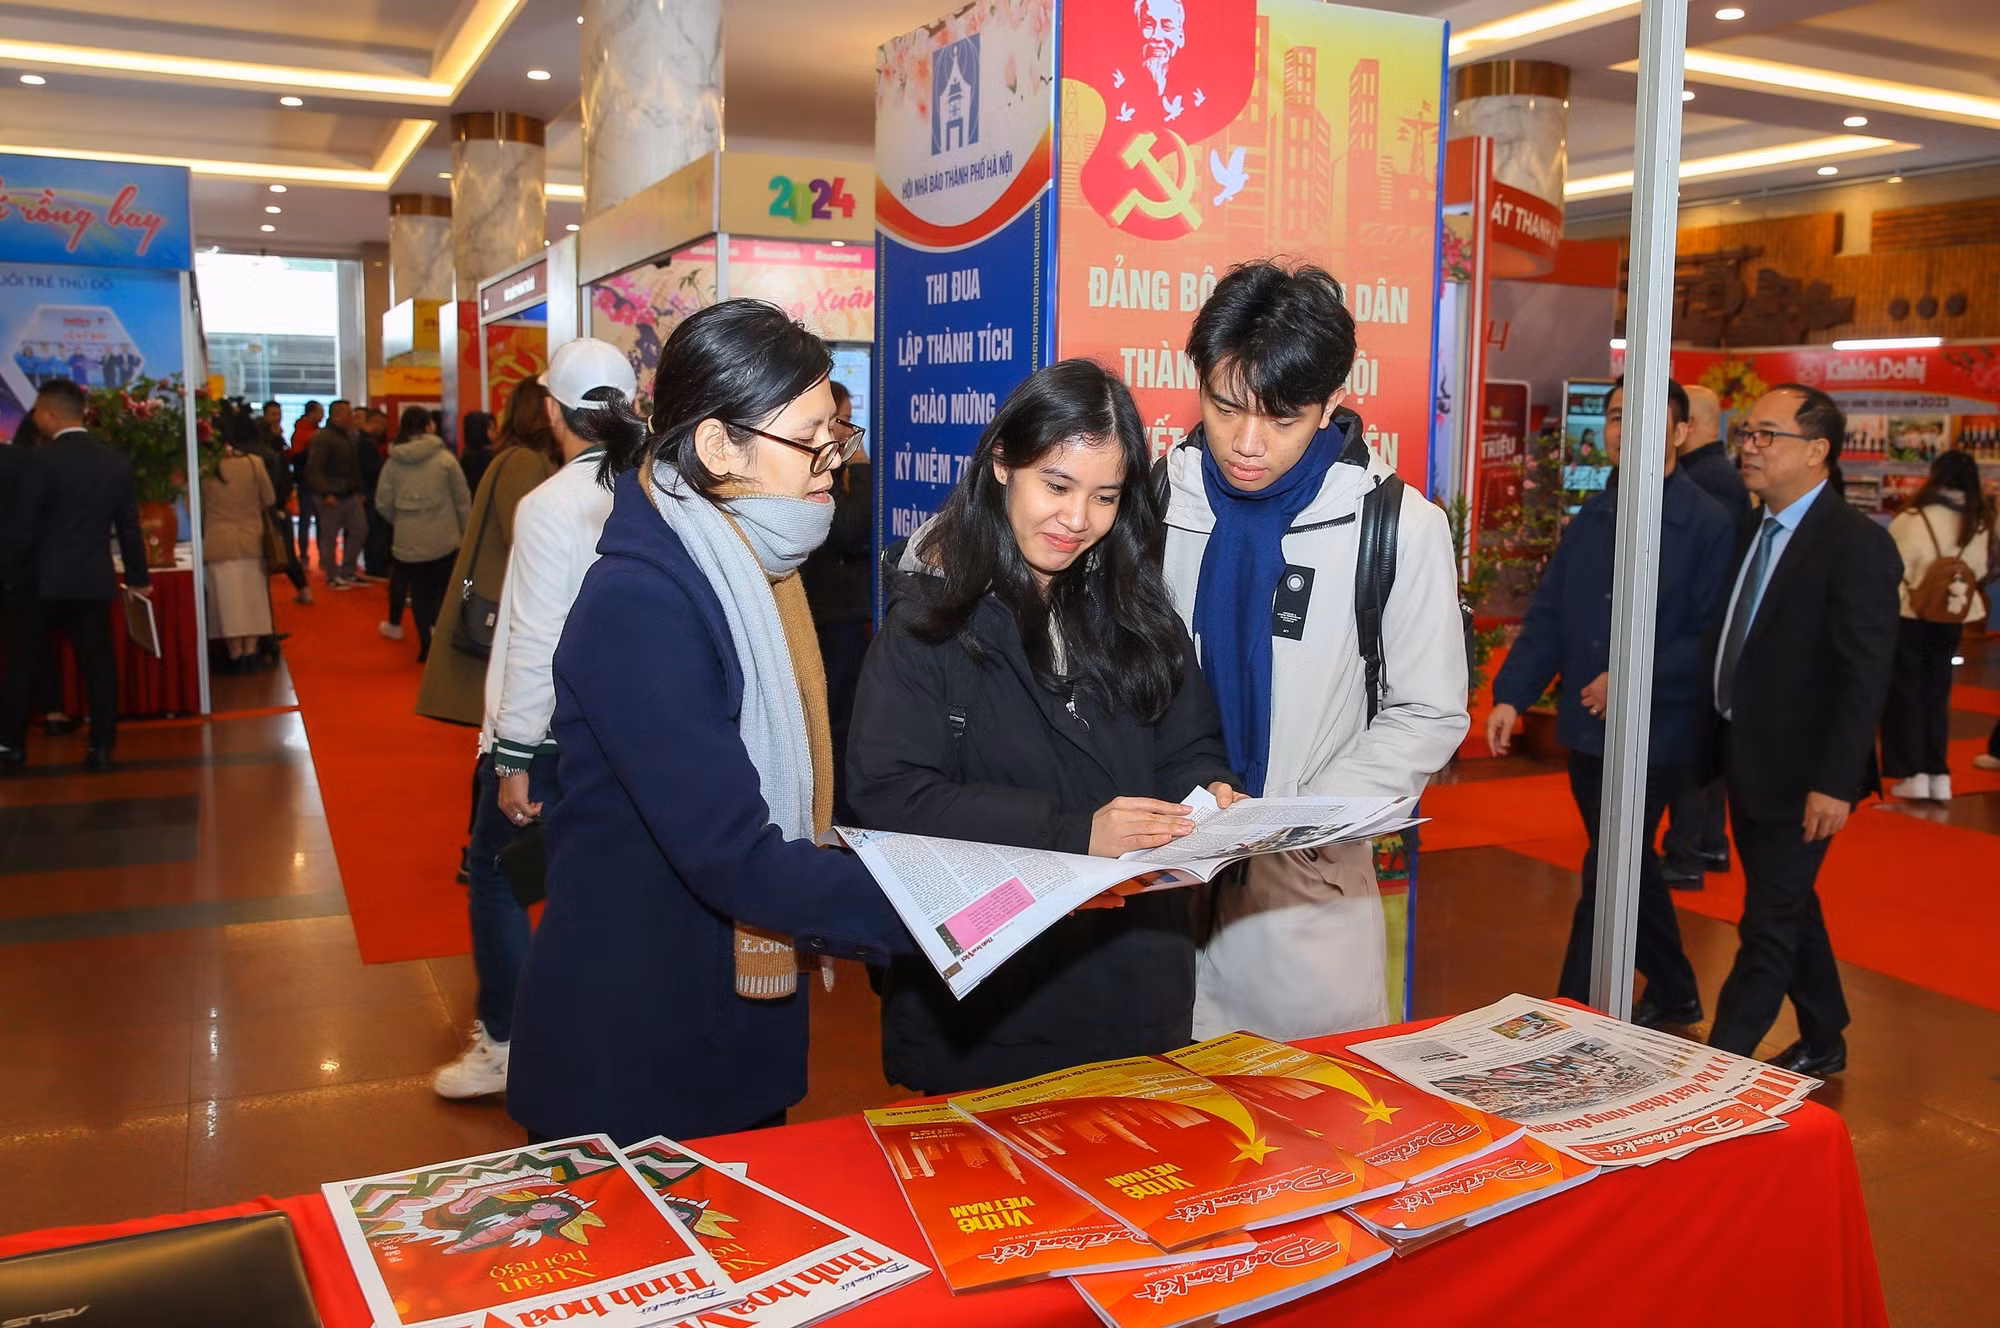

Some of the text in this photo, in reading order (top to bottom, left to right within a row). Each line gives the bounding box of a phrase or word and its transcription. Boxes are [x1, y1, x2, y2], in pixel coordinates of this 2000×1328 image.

[929, 171, 943, 193] BÁO
[944, 164, 969, 188] THÀNH
[970, 155, 985, 182] PHỐ
[986, 157, 998, 178] HÀ
[999, 150, 1013, 178] NỘI
[768, 175, 856, 225] 2024
[1490, 193, 1514, 227] ÁT
[20, 184, 169, 256] rồng bay
[926, 268, 981, 305] THI ĐUA
[1088, 254, 1170, 312] ĐẢNG
[1355, 277, 1409, 325] DÂN
[898, 322, 1013, 372] LẬP THÀNH TÍCH
[1120, 341, 1200, 390] THÀN
[910, 386, 996, 426] CHÀO MỪNG
[1145, 413, 1399, 470] ẾT ÊN
[895, 442, 912, 481] KỶ
[915, 446, 951, 490] NIỆM
[1665, 1081, 1714, 1101] Xuất
[1104, 1168, 1148, 1188] NAM
[949, 1201, 997, 1219] NAM
[489, 1247, 590, 1280] hội ngộ
[496, 1264, 599, 1293] Xuân
[797, 1247, 896, 1286] Tinh
[607, 1267, 716, 1307] Tinh
[728, 1278, 812, 1315] hoa
[515, 1294, 610, 1328] hoa
